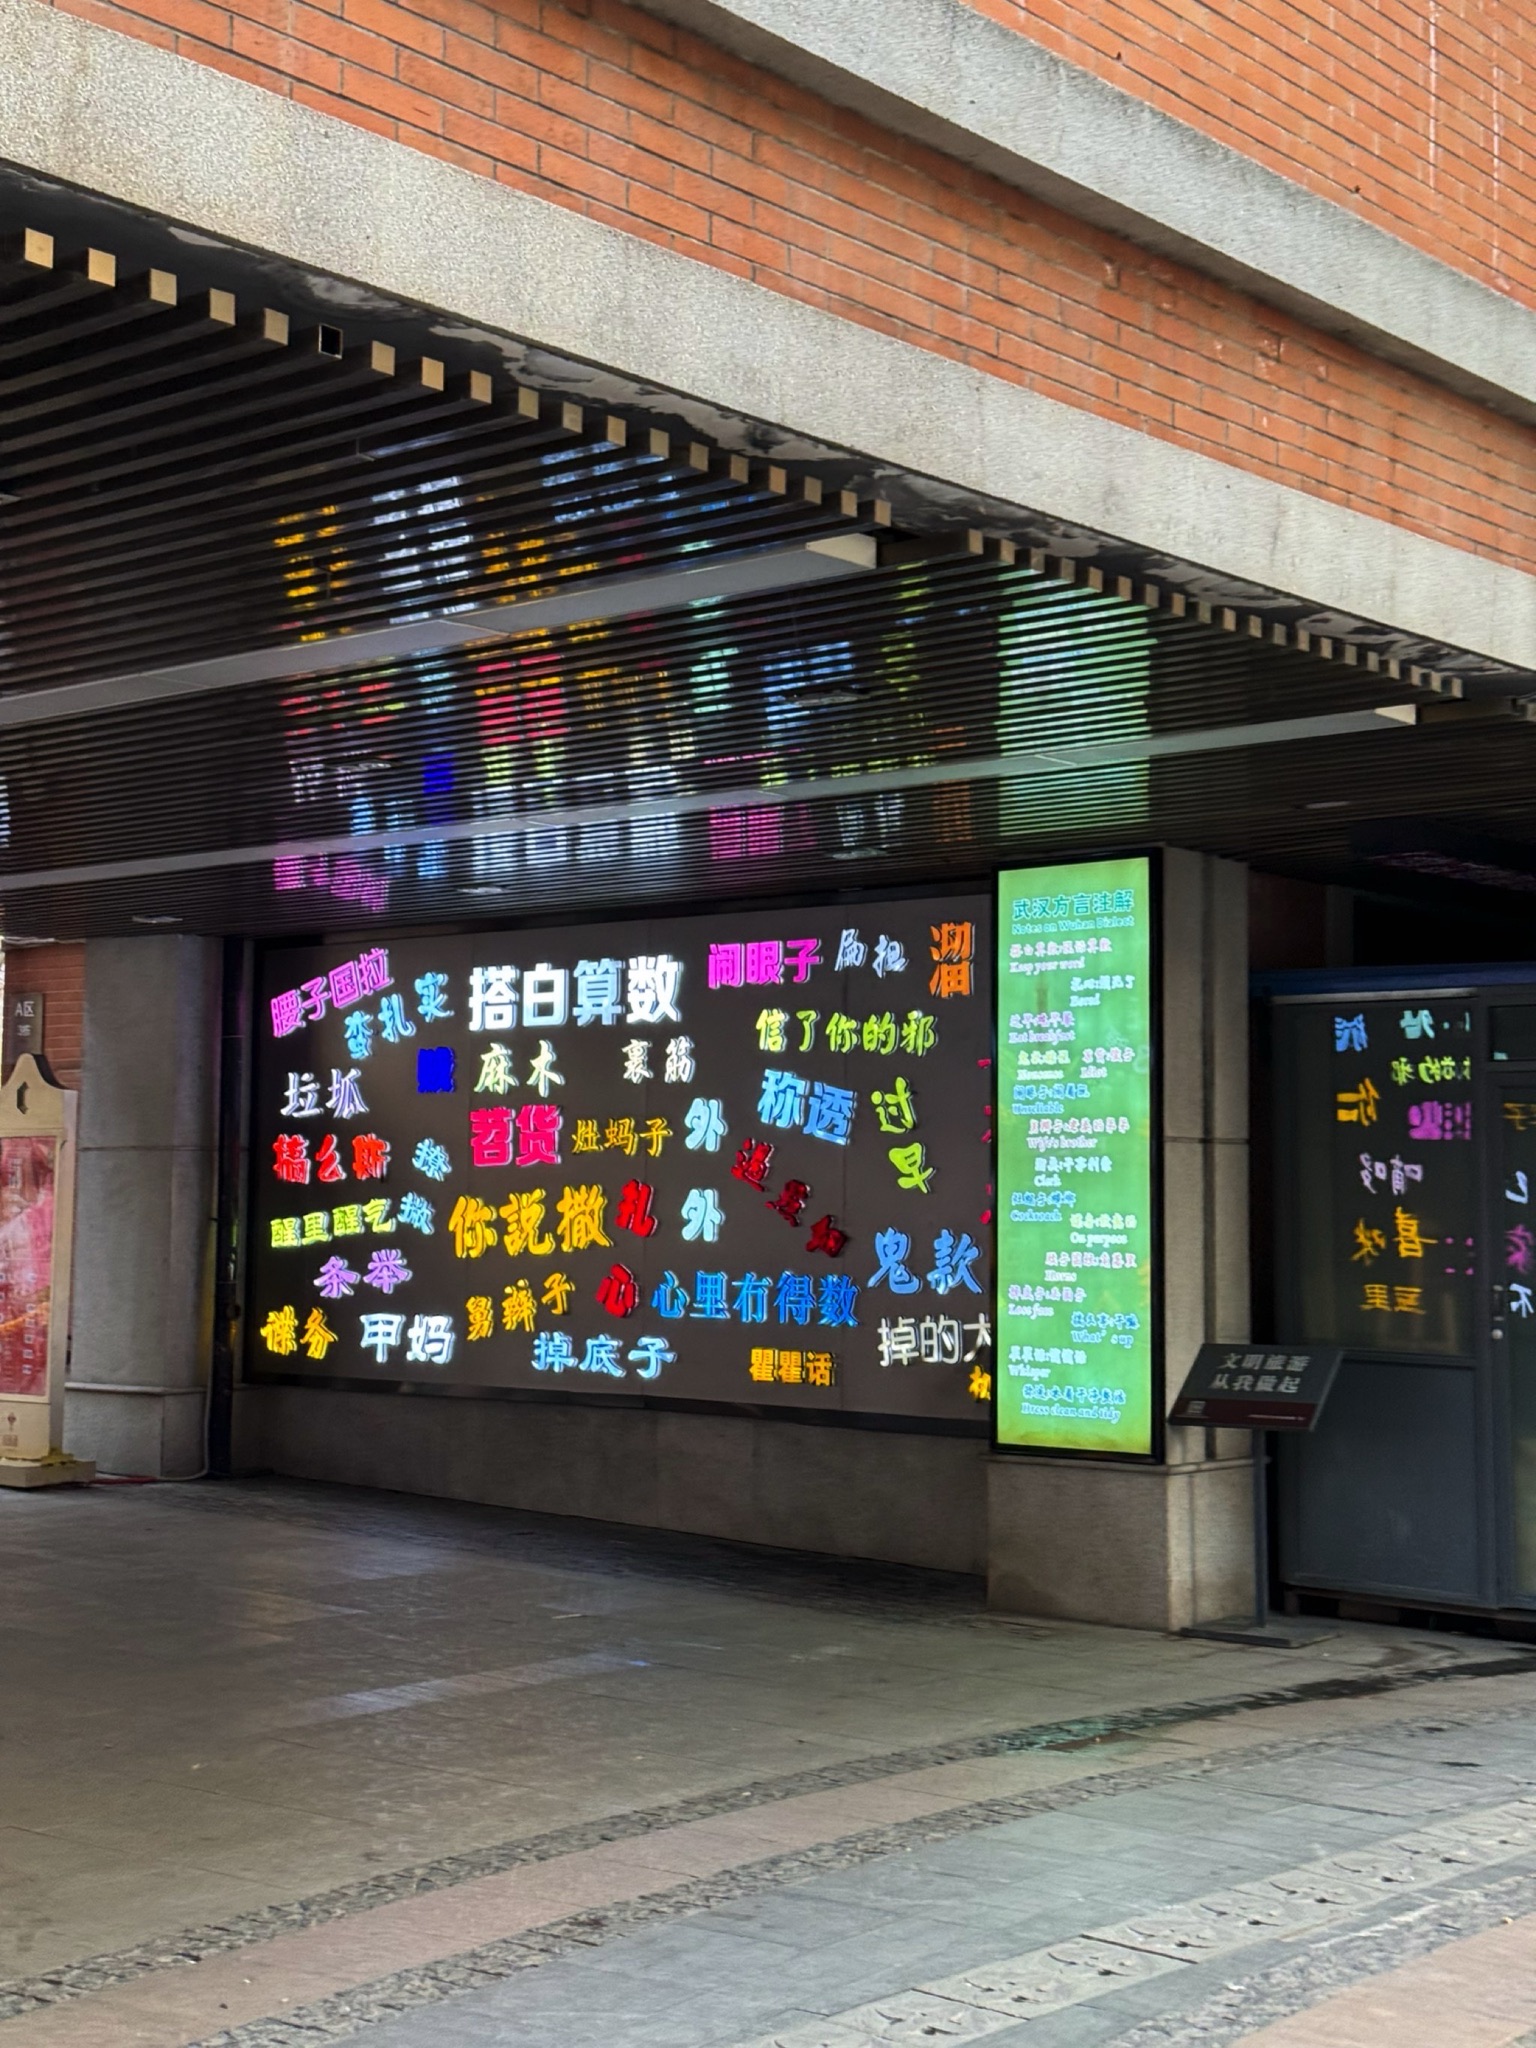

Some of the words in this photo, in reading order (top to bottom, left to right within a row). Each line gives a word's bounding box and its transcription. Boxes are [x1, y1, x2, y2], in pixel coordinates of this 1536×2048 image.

[1012, 889, 1134, 920] 武汉方言注解
[1012, 923, 1042, 935] Notes
[1043, 922, 1057, 933] on
[1058, 918, 1095, 932] Wuhan
[1096, 915, 1134, 929] Dialect
[708, 938, 821, 989] 闹眼子
[1034, 961, 1059, 976] your
[1060, 956, 1085, 970] word
[15, 1001, 35, 1017] A区
[468, 954, 684, 1032] 搭白算数
[756, 1008, 937, 1057] 信了你的邪
[474, 1040, 564, 1097] 麻木
[756, 1068, 856, 1146] 称透
[468, 1104, 563, 1168] 苕货
[871, 1076, 935, 1193] 过早
[1059, 1134, 1098, 1149] brother
[270, 1198, 396, 1249] 醒里醒气
[1010, 1207, 1062, 1222] Cockroach
[867, 1227, 982, 1295] 鬼款
[1069, 1231, 1086, 1244] On
[1086, 1233, 1128, 1248] purpose
[531, 1331, 677, 1378] 掉底子
[1209, 1374, 1300, 1393] 从我做起
[1021, 1402, 1050, 1416] Dress
[1050, 1403, 1077, 1417] clean
[1077, 1405, 1099, 1419] and
[1099, 1405, 1122, 1425] tidy
